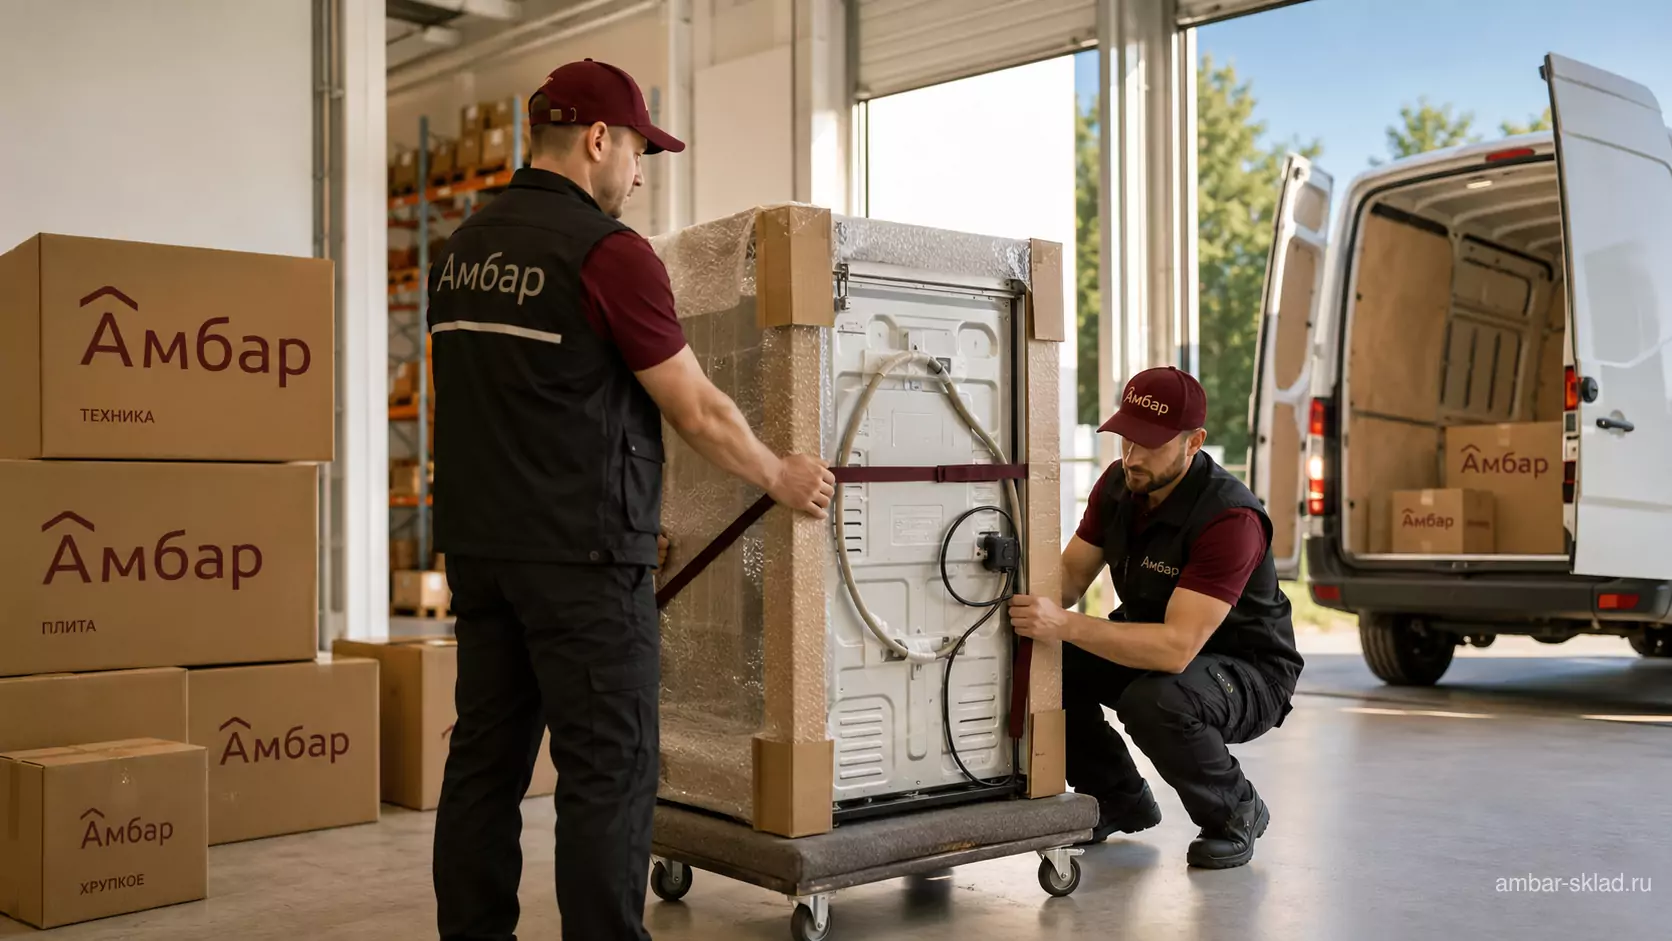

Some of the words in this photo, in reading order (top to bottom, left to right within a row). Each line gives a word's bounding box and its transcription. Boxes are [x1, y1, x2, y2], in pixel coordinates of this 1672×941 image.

[436, 251, 545, 306] Амбар
[80, 312, 312, 389] Амбар
[80, 408, 155, 424] ТЕХНИКА
[1124, 391, 1169, 416] Амбар
[1460, 452, 1549, 479] Амбар
[1402, 513, 1454, 530] Амбар
[42, 529, 263, 591] Амбар
[1140, 556, 1180, 578] Амбар
[42, 619, 97, 635] ПЛИТА
[219, 725, 350, 766] Амбар
[81, 816, 174, 850] Амбар
[80, 873, 145, 896] ХРУПКОЕ
